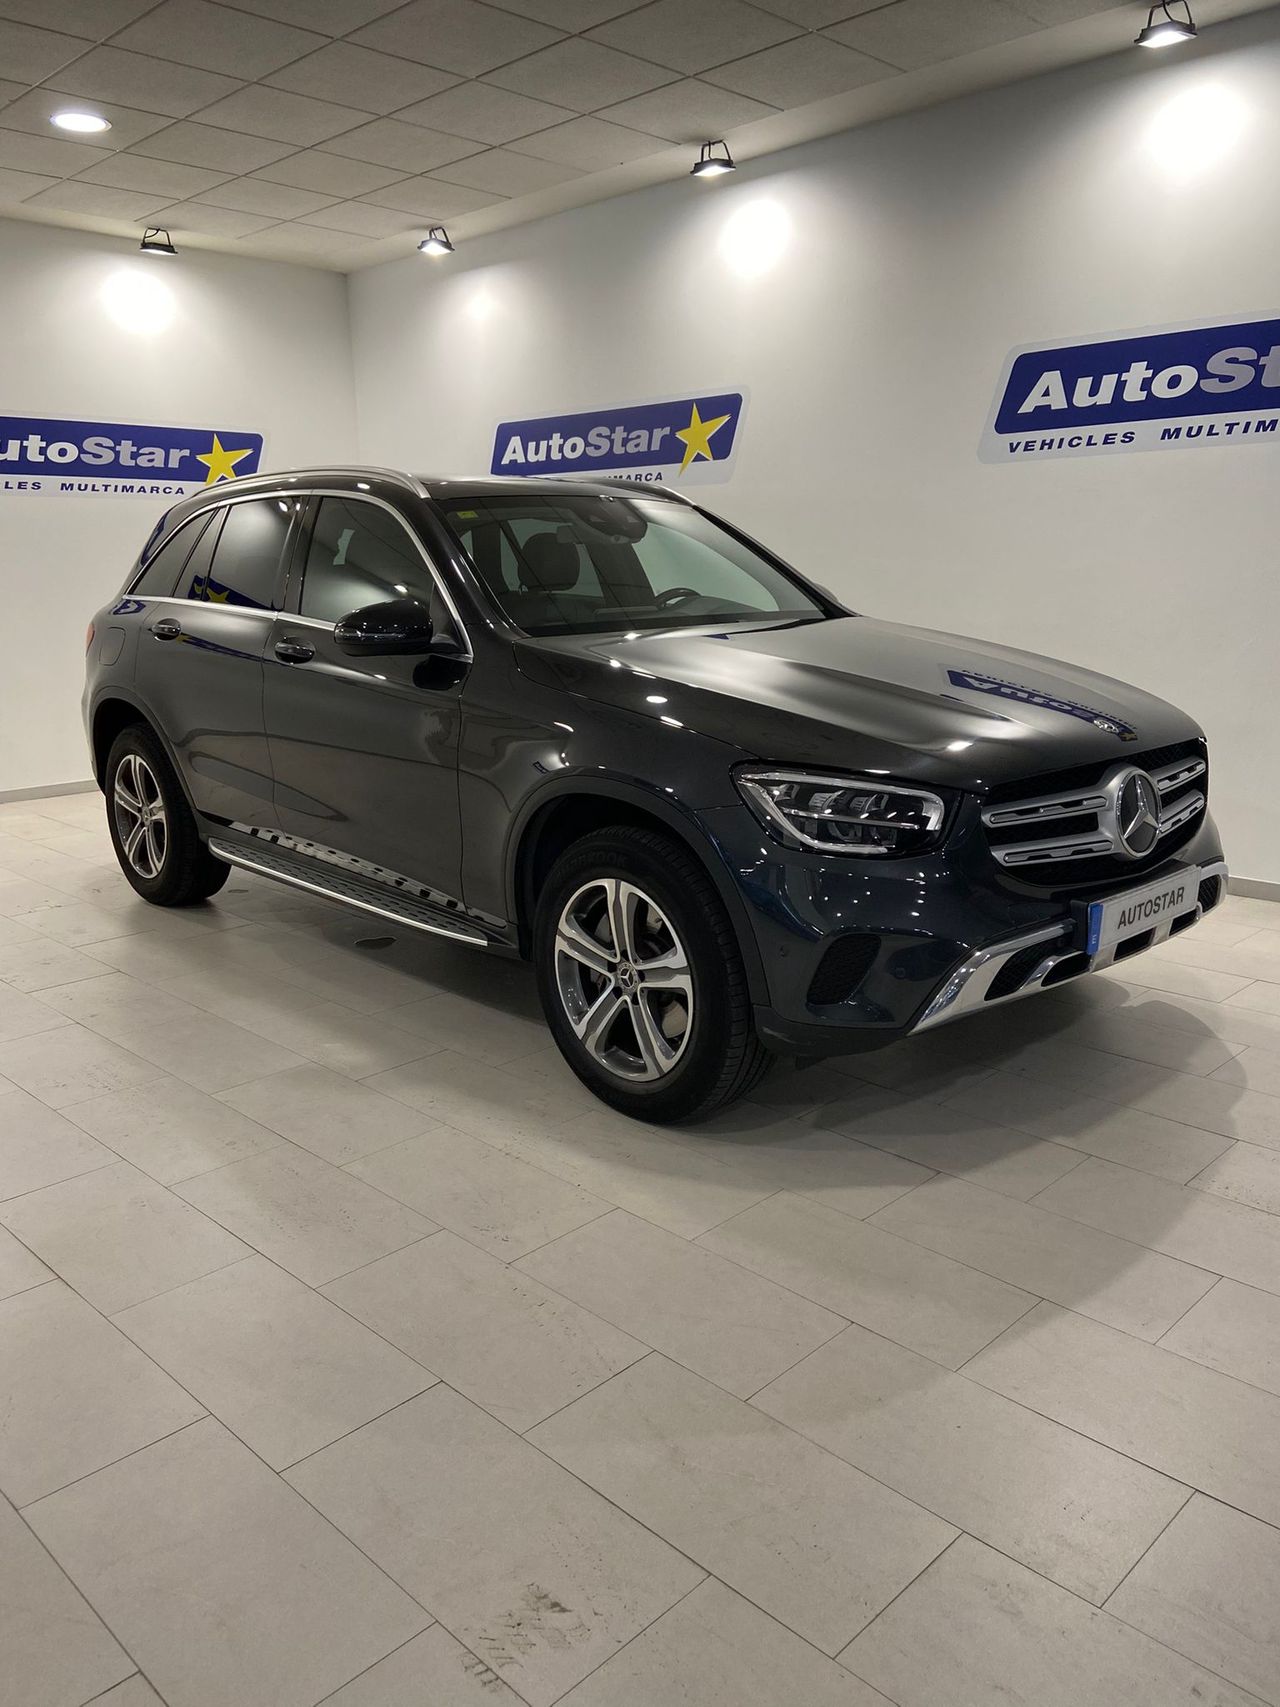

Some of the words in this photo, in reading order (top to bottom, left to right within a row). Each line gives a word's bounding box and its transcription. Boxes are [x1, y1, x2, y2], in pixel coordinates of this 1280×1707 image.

[1017, 345, 1280, 414] AutoSt
[0, 434, 190, 468] utoStar
[500, 426, 670, 465] AutoStar
[1008, 431, 1136, 453] VEHICLES
[1160, 419, 1279, 440] MULTIM
[60, 482, 185, 495] MULTIMARCA
[1117, 886, 1185, 930] AUTOSTAR
